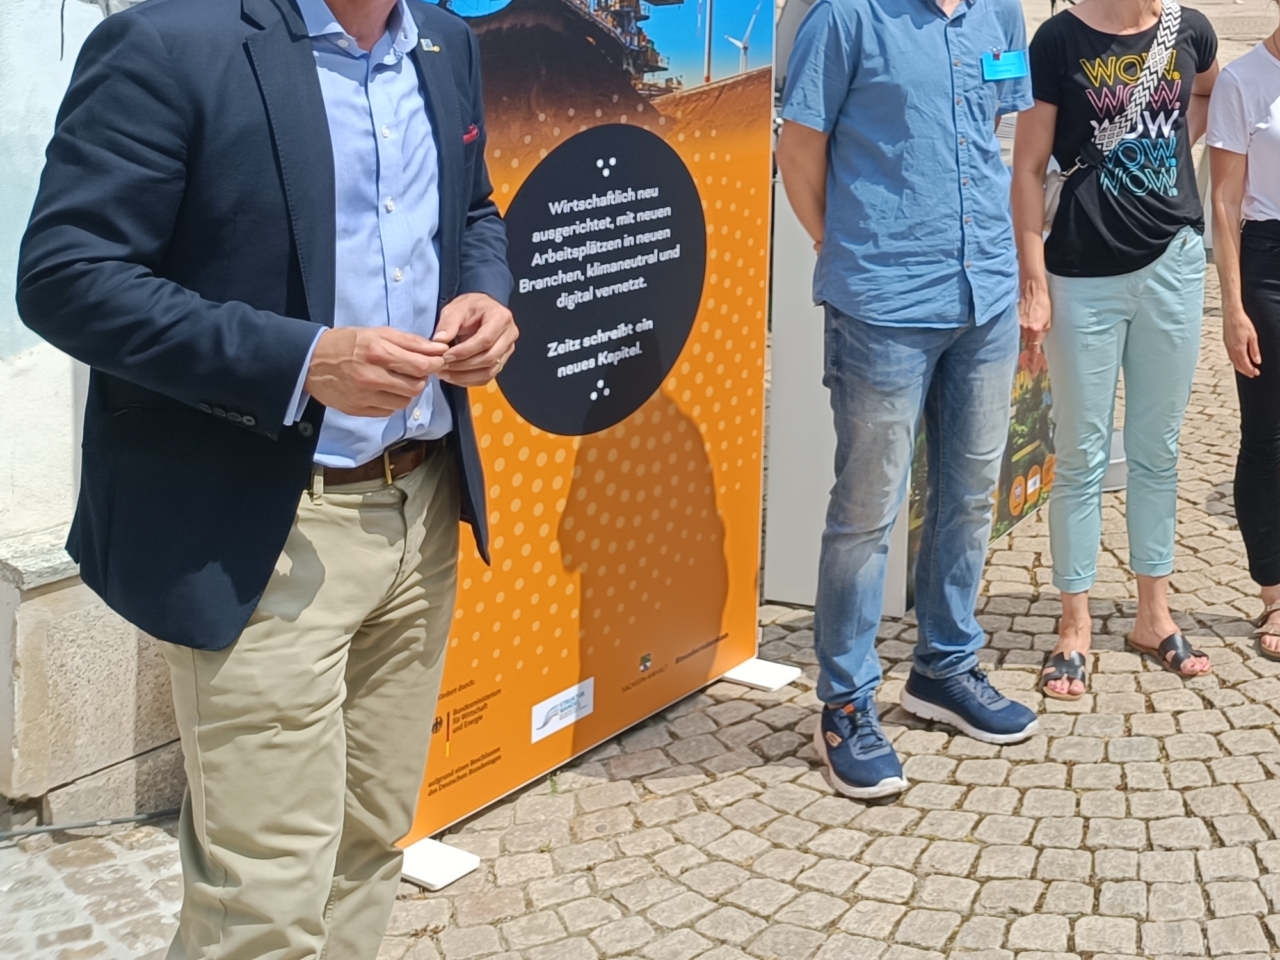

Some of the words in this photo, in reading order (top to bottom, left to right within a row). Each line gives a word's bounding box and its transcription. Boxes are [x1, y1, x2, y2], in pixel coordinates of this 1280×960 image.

[548, 188, 635, 215] Wirtschaftlich
[637, 187, 659, 199] neu
[532, 218, 615, 243] ausgerichtet,
[616, 211, 635, 226] mit
[637, 206, 671, 221] neuen
[531, 237, 622, 267] Arbeitsplätzen
[623, 234, 634, 247] in
[636, 228, 671, 244] neuen
[519, 269, 585, 293] Branchen,
[586, 249, 658, 278] klimaneutral
[659, 244, 681, 261] und
[556, 285, 594, 310] digital
[595, 276, 647, 299] vernetzt.
[547, 338, 581, 358] Zeitz
[582, 322, 634, 348] schreibt
[635, 318, 653, 332] ein
[557, 359, 596, 378] neues
[597, 341, 643, 366] Kapitel.
